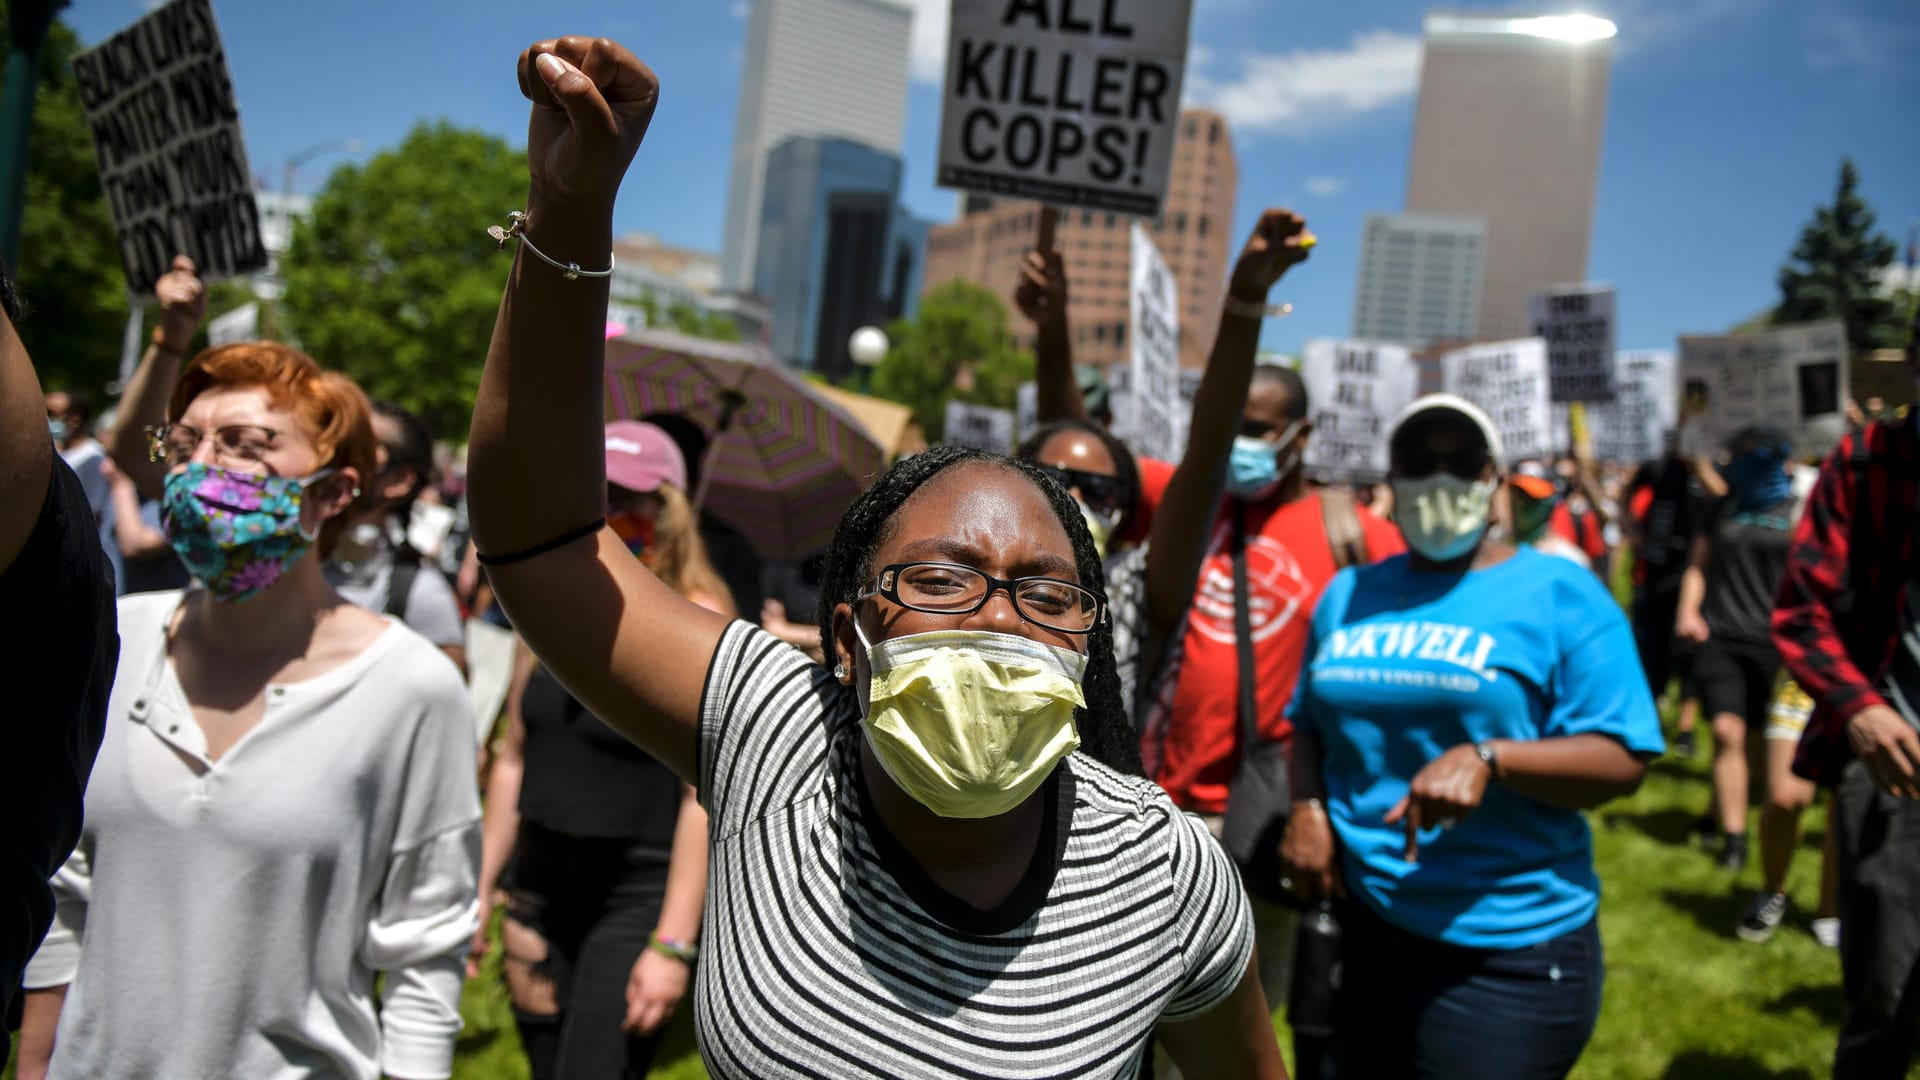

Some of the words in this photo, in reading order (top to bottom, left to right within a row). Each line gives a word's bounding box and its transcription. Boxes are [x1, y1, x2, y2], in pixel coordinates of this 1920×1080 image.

[74, 27, 148, 110] BLACK
[146, 0, 213, 68] LIVES
[1003, 0, 1134, 39] ALL
[955, 38, 1171, 123] KILLER
[961, 106, 1149, 188] COPS!
